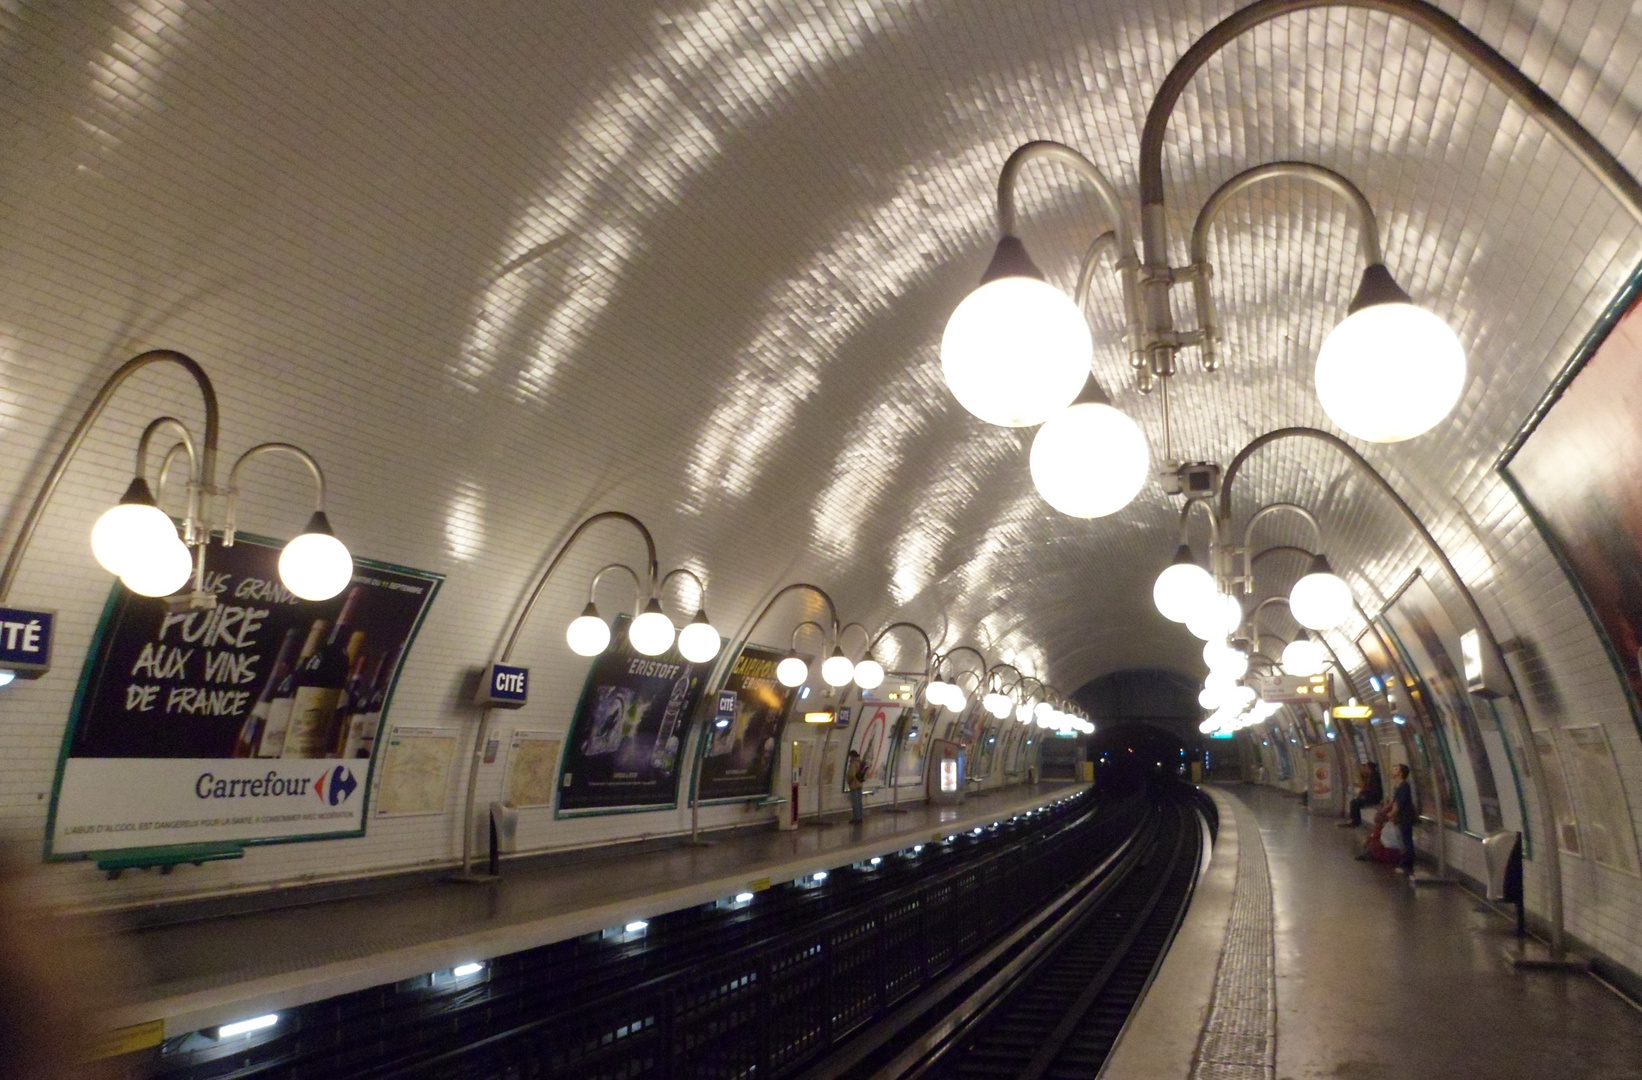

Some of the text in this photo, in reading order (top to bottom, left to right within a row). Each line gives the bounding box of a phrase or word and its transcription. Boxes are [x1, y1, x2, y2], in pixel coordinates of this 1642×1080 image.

[0, 619, 42, 653] TÉ
[130, 642, 261, 684] AUX VINS
[125, 683, 250, 716] DE FRANCE
[496, 672, 525, 694] CITÉ
[195, 771, 311, 799] Carrefour
